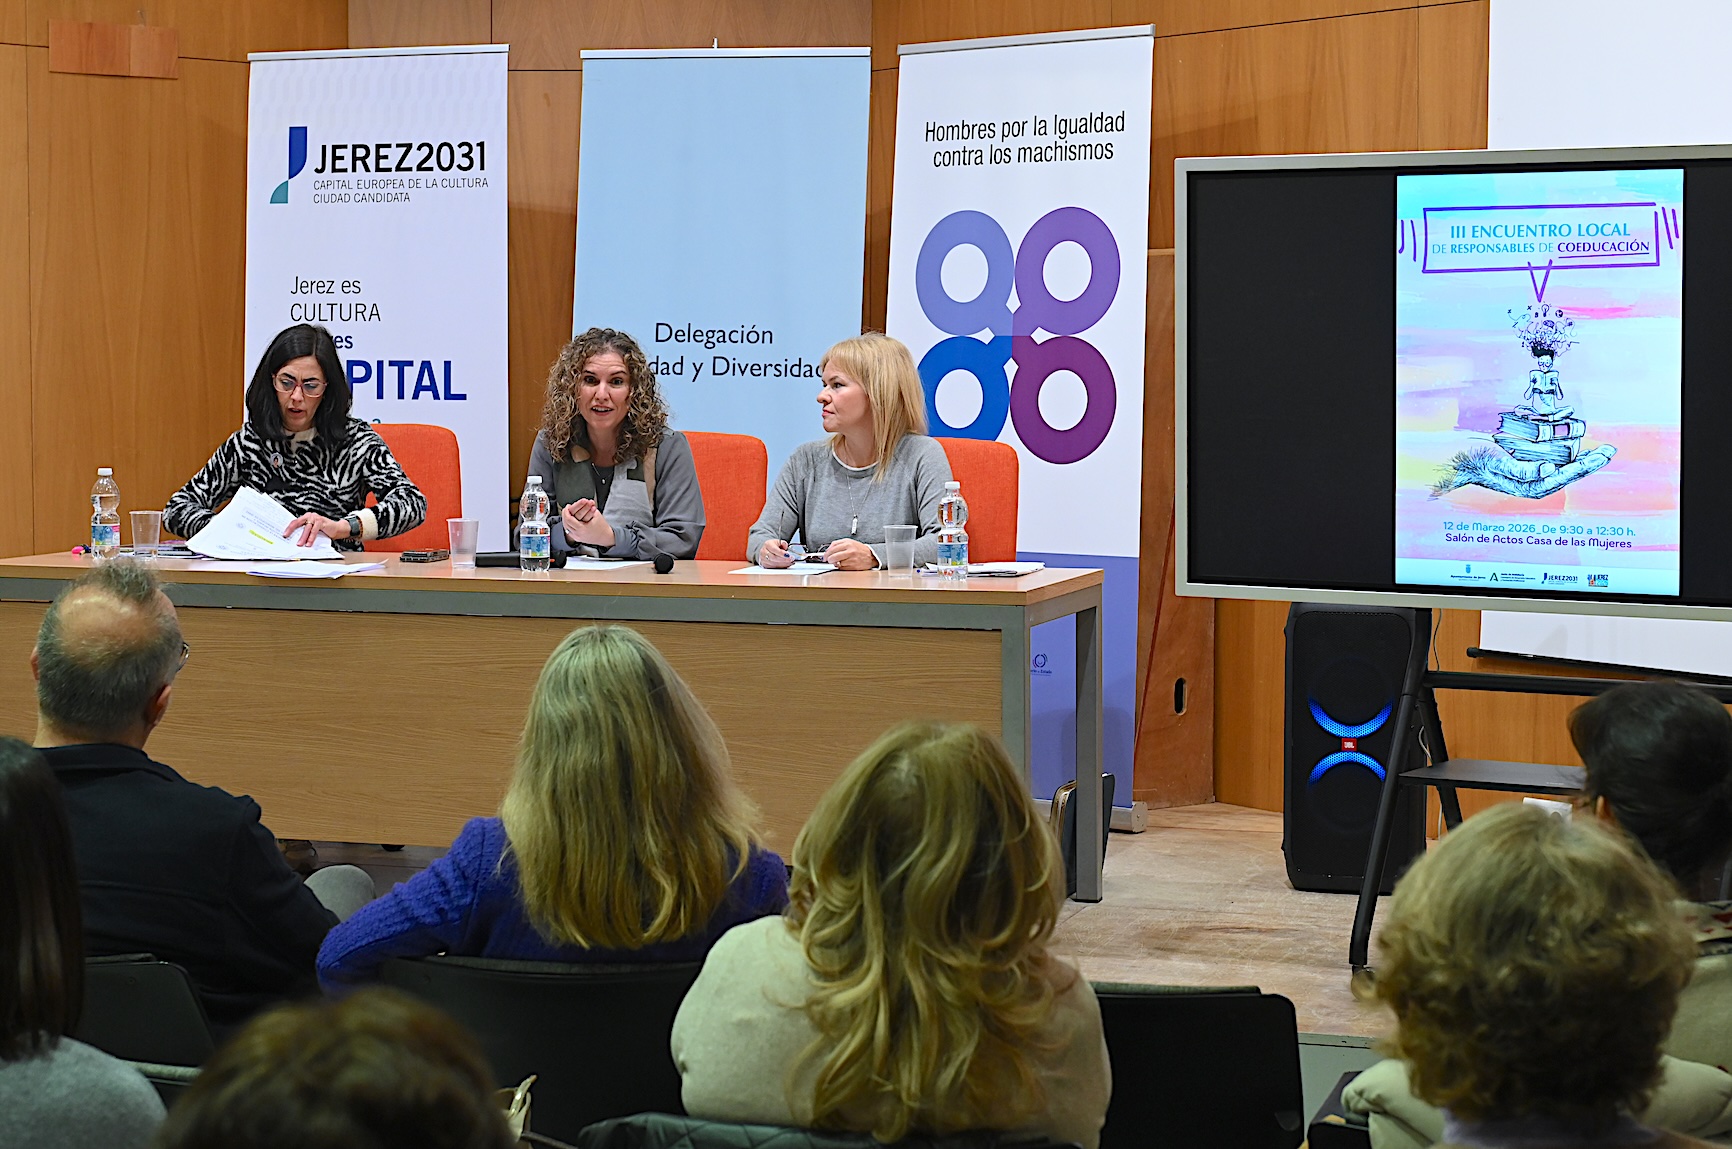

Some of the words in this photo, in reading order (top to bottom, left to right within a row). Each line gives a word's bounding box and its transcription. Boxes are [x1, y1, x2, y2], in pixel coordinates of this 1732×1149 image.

[925, 120, 996, 142] Hombres
[1001, 120, 1028, 142] por
[1033, 115, 1047, 136] la
[1053, 110, 1126, 140] Igualdad
[314, 141, 485, 174] JEREZ2031
[932, 145, 984, 168] contra
[988, 143, 1012, 166] los
[1017, 141, 1114, 163] machismos
[313, 178, 354, 190] CAPITAL
[357, 178, 405, 190] EUROPEA
[408, 178, 422, 189] DE
[425, 178, 438, 189] LA
[441, 177, 489, 189] CULTURA
[313, 193, 351, 204] CIUDAD
[353, 192, 411, 203] CANDIDATA
[1449, 224, 1466, 239] III
[1470, 222, 1573, 239] ENCUENTRO
[1576, 222, 1631, 237] LOCAL
[1431, 242, 1447, 255] DE
[1449, 242, 1536, 254] RESPONSABLES
[1537, 242, 1554, 254] DE
[1556, 238, 1650, 254] COEDUCACIÓN
[290, 276, 335, 295] Jerez
[341, 280, 361, 295] es
[290, 303, 381, 322] CULTURA
[334, 334, 354, 350] es
[655, 323, 773, 349] Delegación
[346, 359, 468, 401] PITAL
[691, 361, 704, 382] y
[1444, 521, 1454, 531] 12
[1456, 521, 1470, 532] de
[1472, 521, 1505, 533] Marzo
[1559, 524, 1584, 535] 9:30
[1596, 526, 1624, 537] 12:30
[1626, 526, 1637, 537] h.
[1445, 532, 1474, 543] Salón
[1476, 533, 1490, 544] de
[1492, 534, 1524, 546] Actos
[1526, 535, 1552, 546] Casa
[1554, 536, 1569, 547] de
[1571, 537, 1587, 548] las
[1588, 538, 1633, 551] Mujeres
